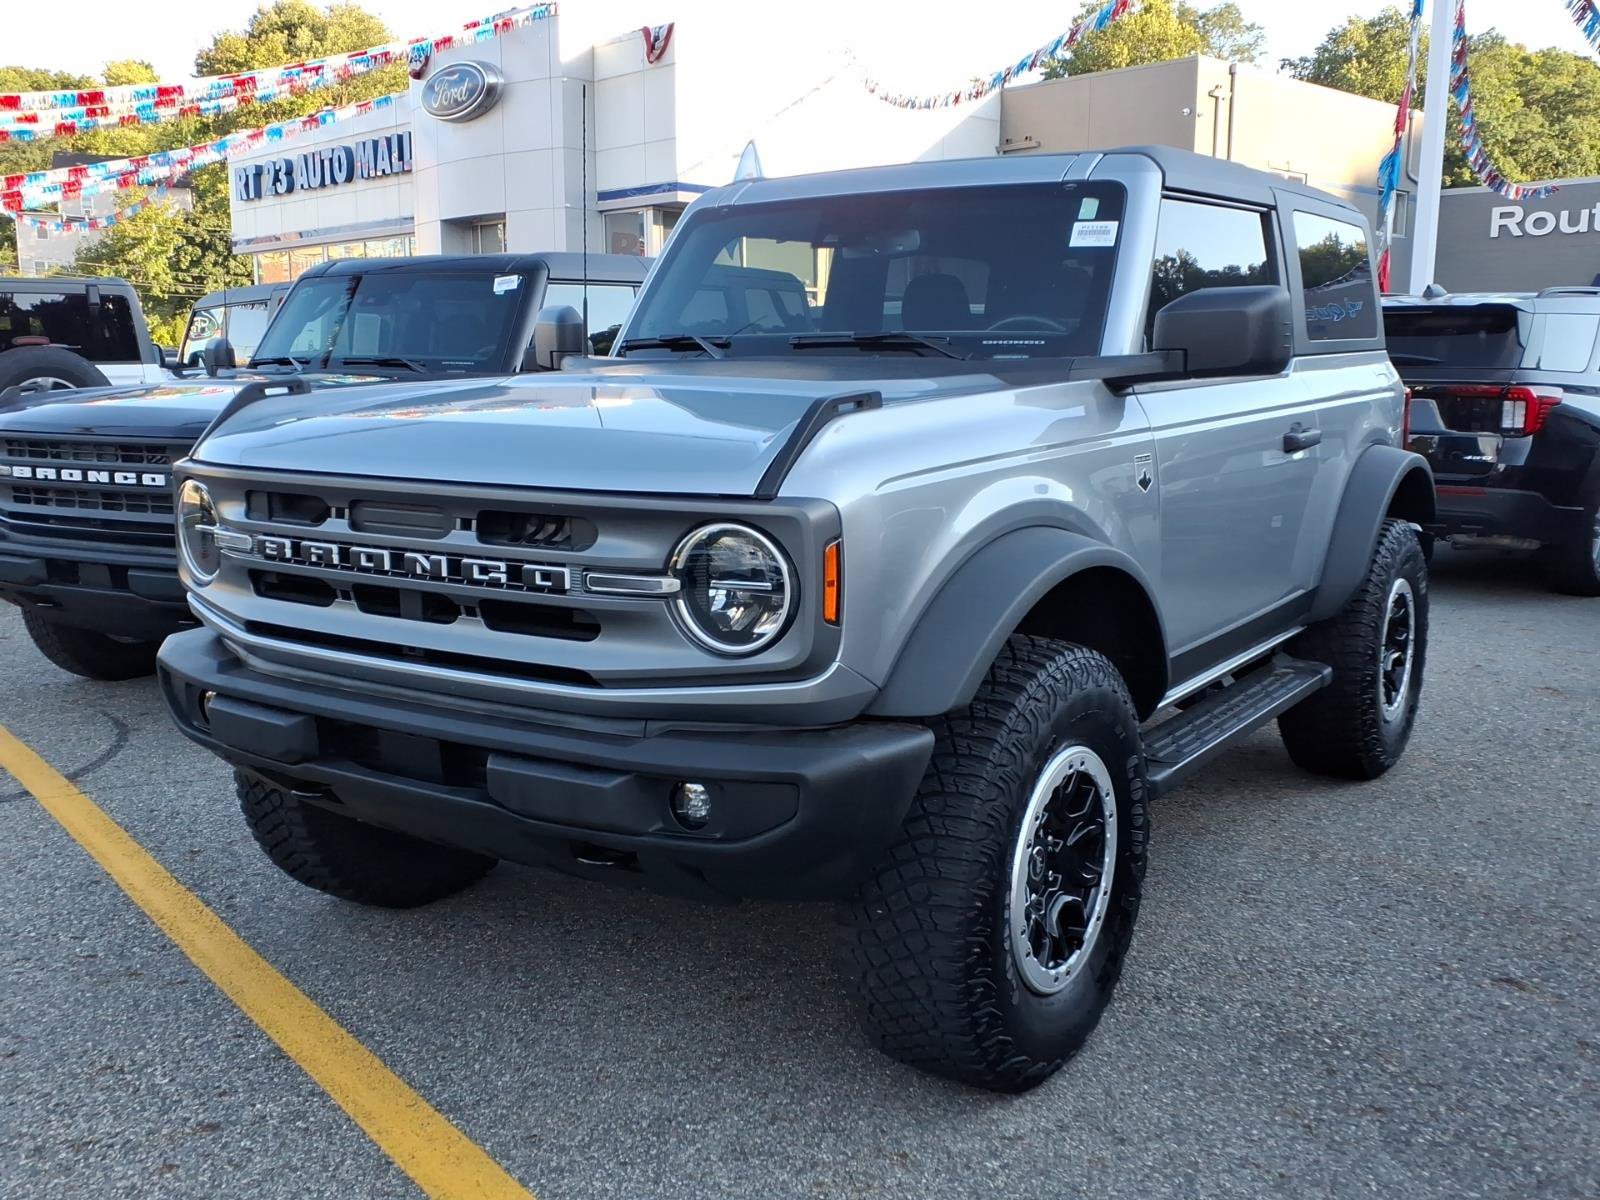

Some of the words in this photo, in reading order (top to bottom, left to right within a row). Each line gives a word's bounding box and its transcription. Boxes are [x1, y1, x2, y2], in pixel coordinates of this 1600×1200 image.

[432, 73, 470, 108] Ford
[235, 165, 262, 201] RT
[264, 158, 293, 197] 23
[297, 146, 353, 190] AUTO
[356, 131, 412, 179] MALL
[12, 465, 166, 486] BRONCO
[256, 534, 571, 591] BRONCO
